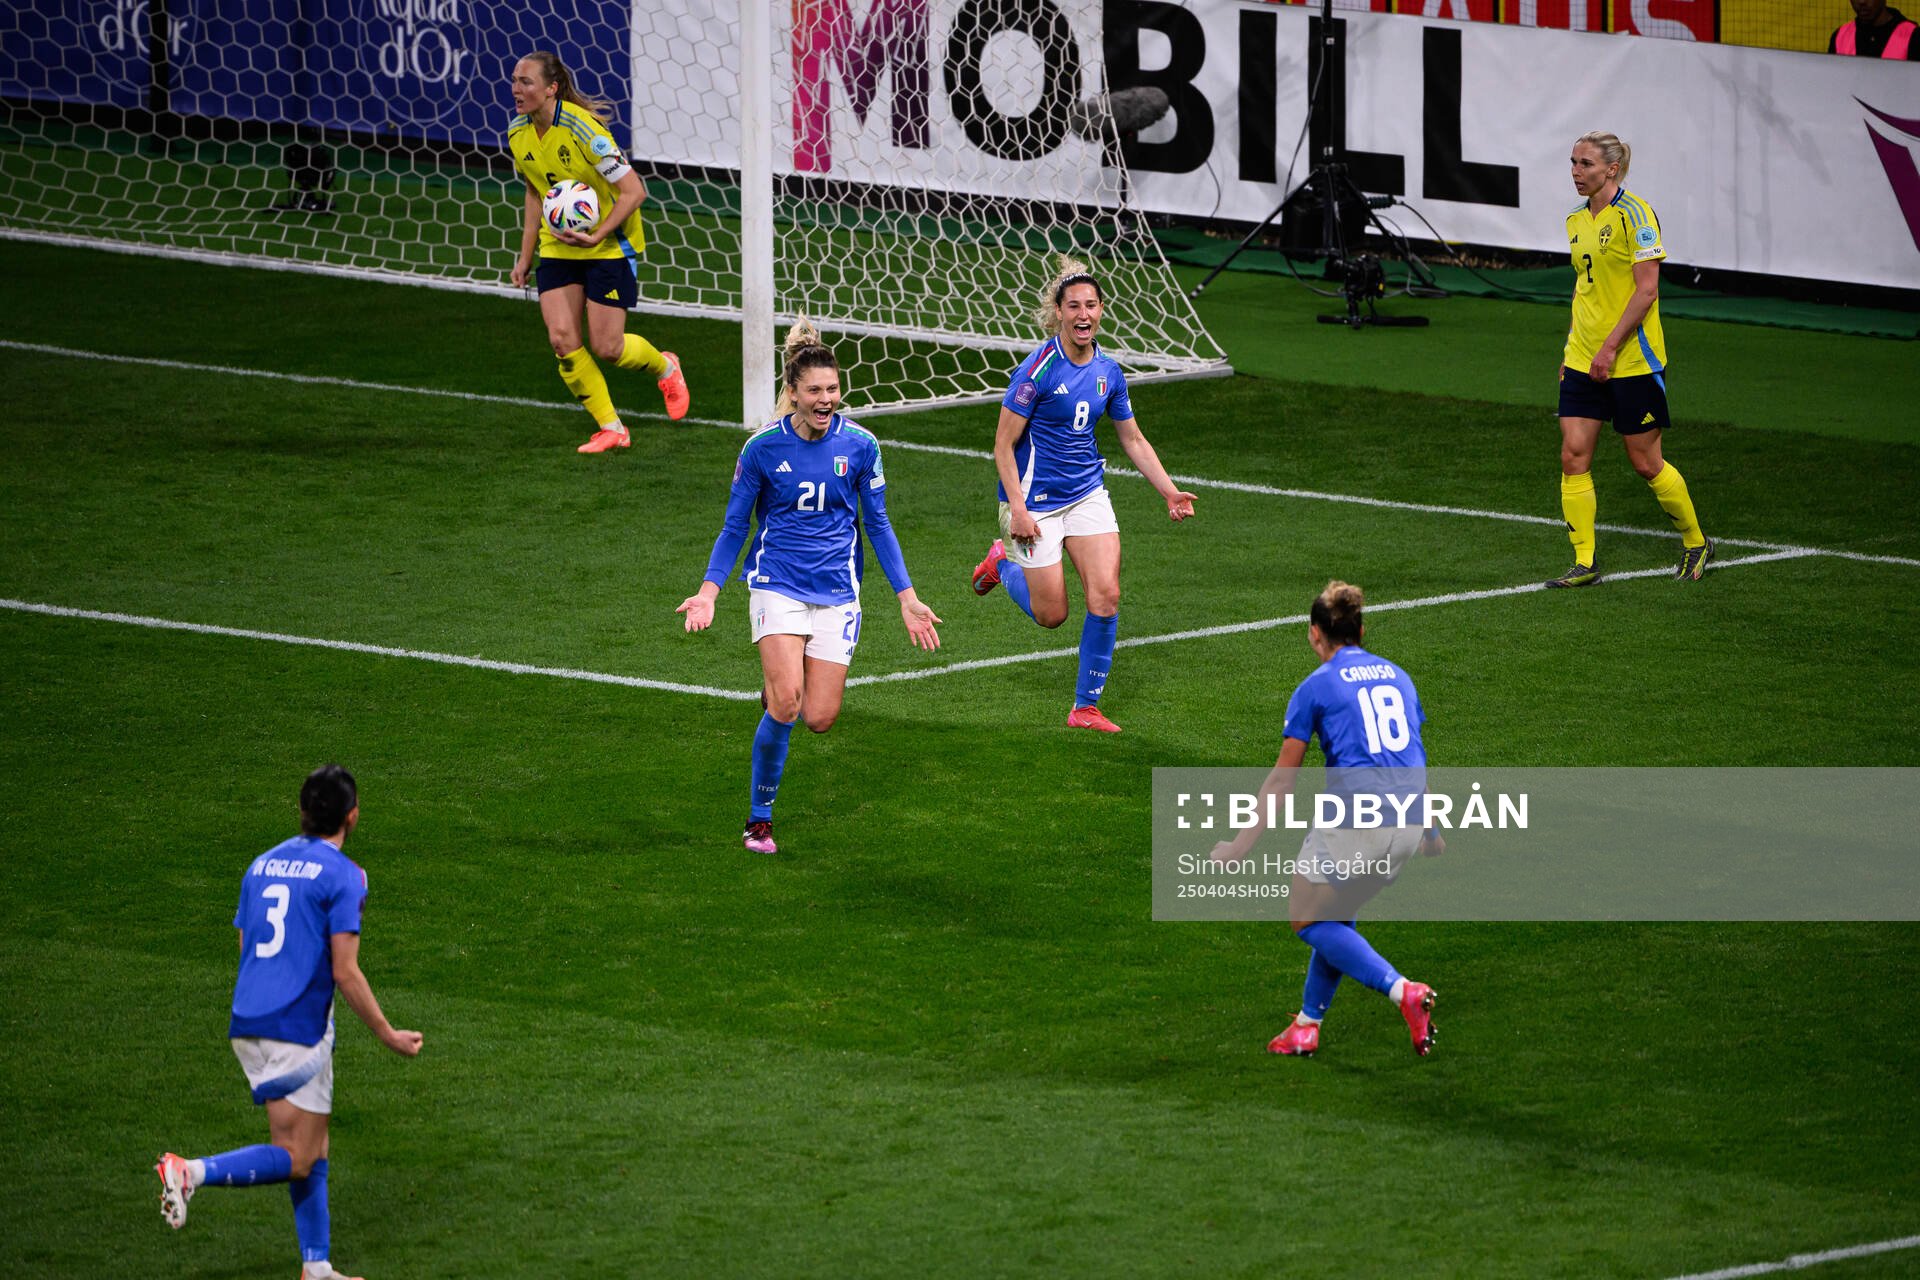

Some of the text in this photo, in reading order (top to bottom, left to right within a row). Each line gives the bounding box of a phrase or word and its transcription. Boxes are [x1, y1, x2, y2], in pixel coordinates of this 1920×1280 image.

[381, 0, 461, 35] qua
[791, 0, 1520, 208] MOBILL
[1582, 253, 1593, 284] 2
[1073, 401, 1090, 431] 8
[797, 481, 826, 512] 21
[1339, 664, 1396, 683] CARUSO
[1357, 684, 1411, 754] 18
[255, 883, 291, 959] 3
